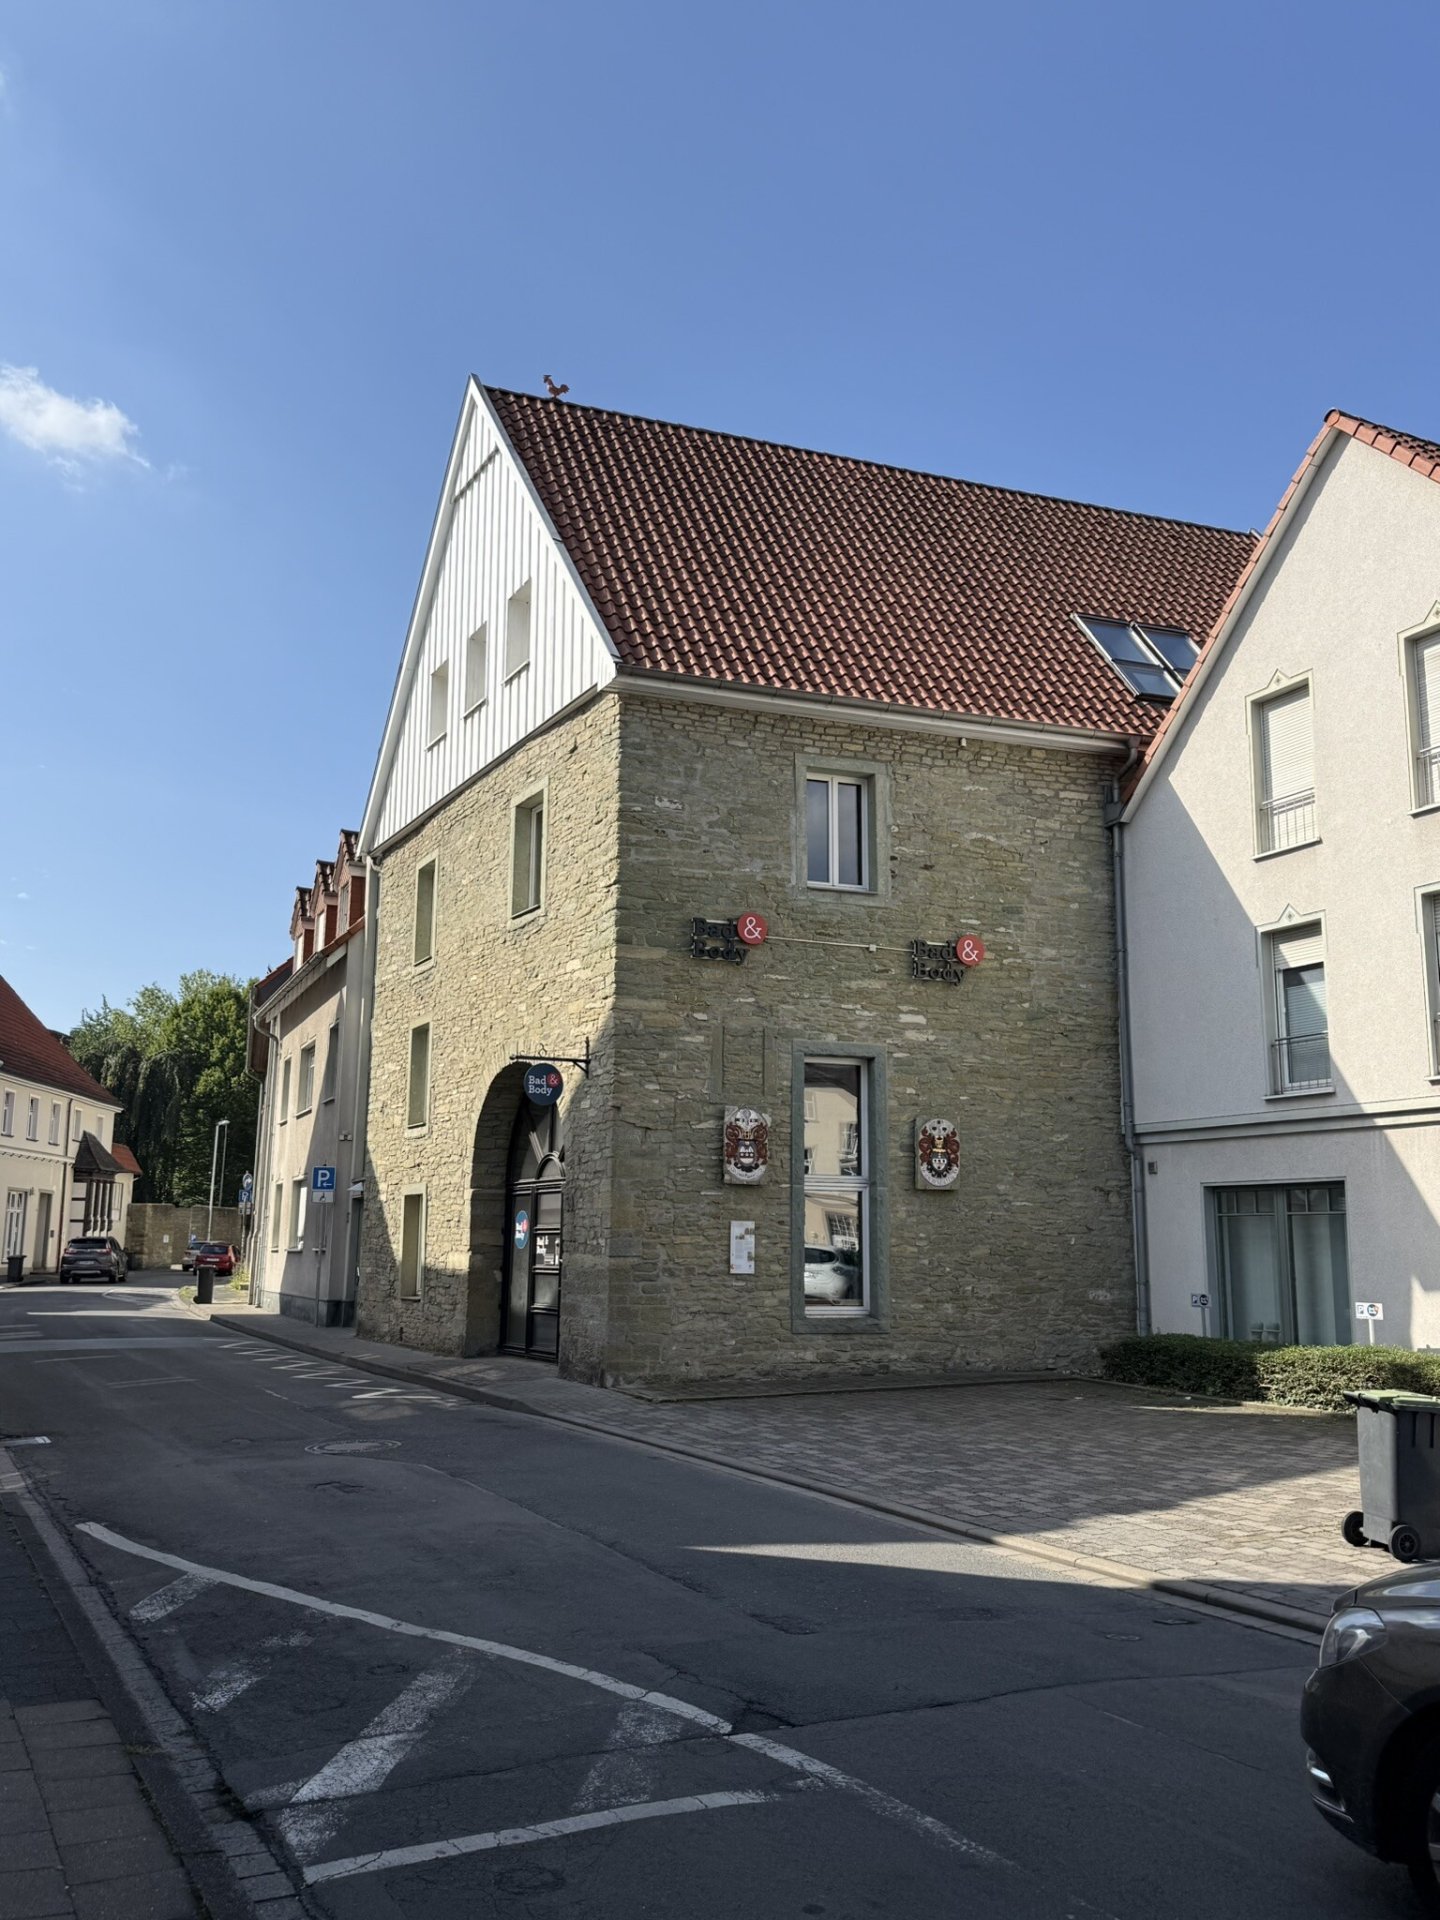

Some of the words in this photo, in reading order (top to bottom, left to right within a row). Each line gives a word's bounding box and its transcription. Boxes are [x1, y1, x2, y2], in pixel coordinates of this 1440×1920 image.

[693, 917, 737, 938] Bad
[744, 917, 762, 939] &
[692, 939, 749, 965] Body
[913, 939, 955, 961] Bad
[962, 941, 979, 962] &
[913, 960, 964, 986] Body
[528, 1075, 547, 1085] Bad
[550, 1073, 559, 1085] &
[528, 1084, 553, 1097] Body
[317, 1169, 330, 1187] P
